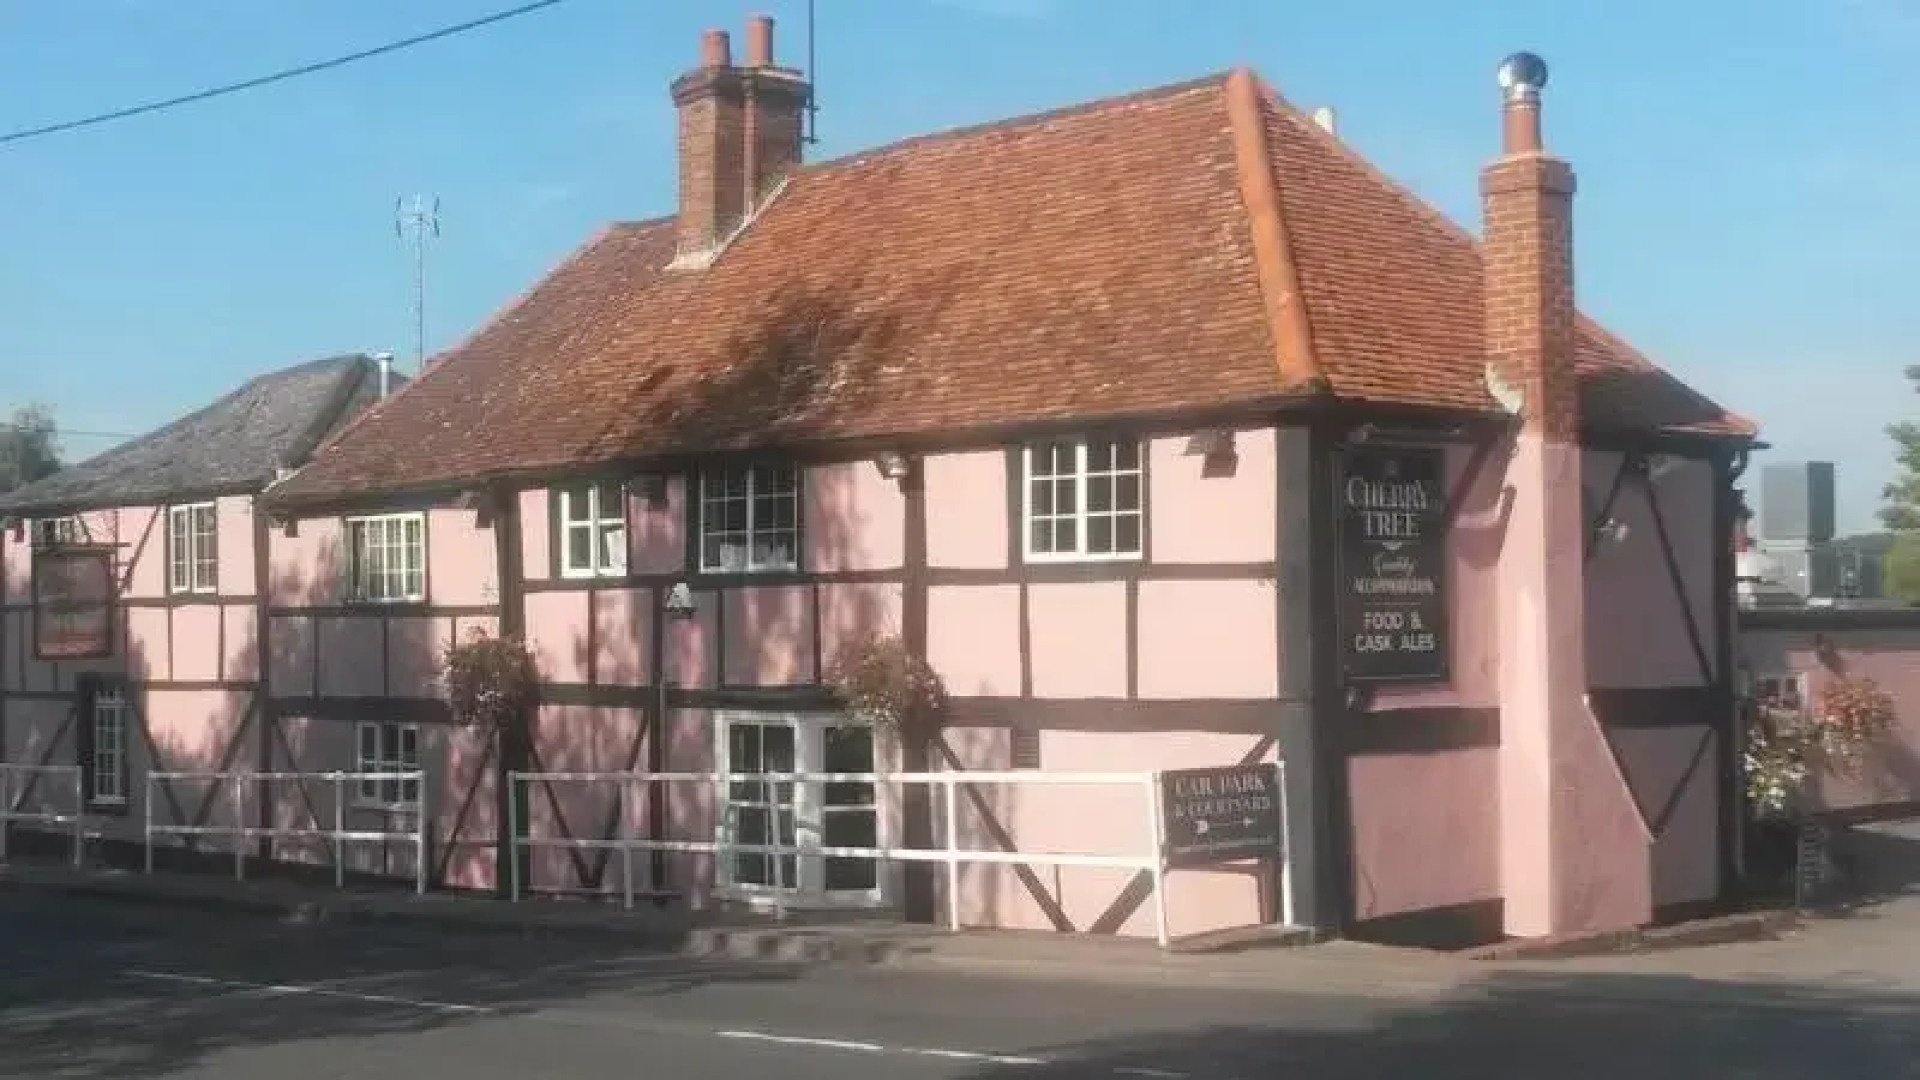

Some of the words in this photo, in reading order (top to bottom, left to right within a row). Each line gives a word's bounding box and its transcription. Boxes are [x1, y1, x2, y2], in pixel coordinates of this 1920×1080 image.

[1364, 512, 1421, 537] TREE
[1363, 611, 1402, 630] FOOD
[1355, 634, 1394, 651] CASK
[1400, 634, 1435, 651] ALES
